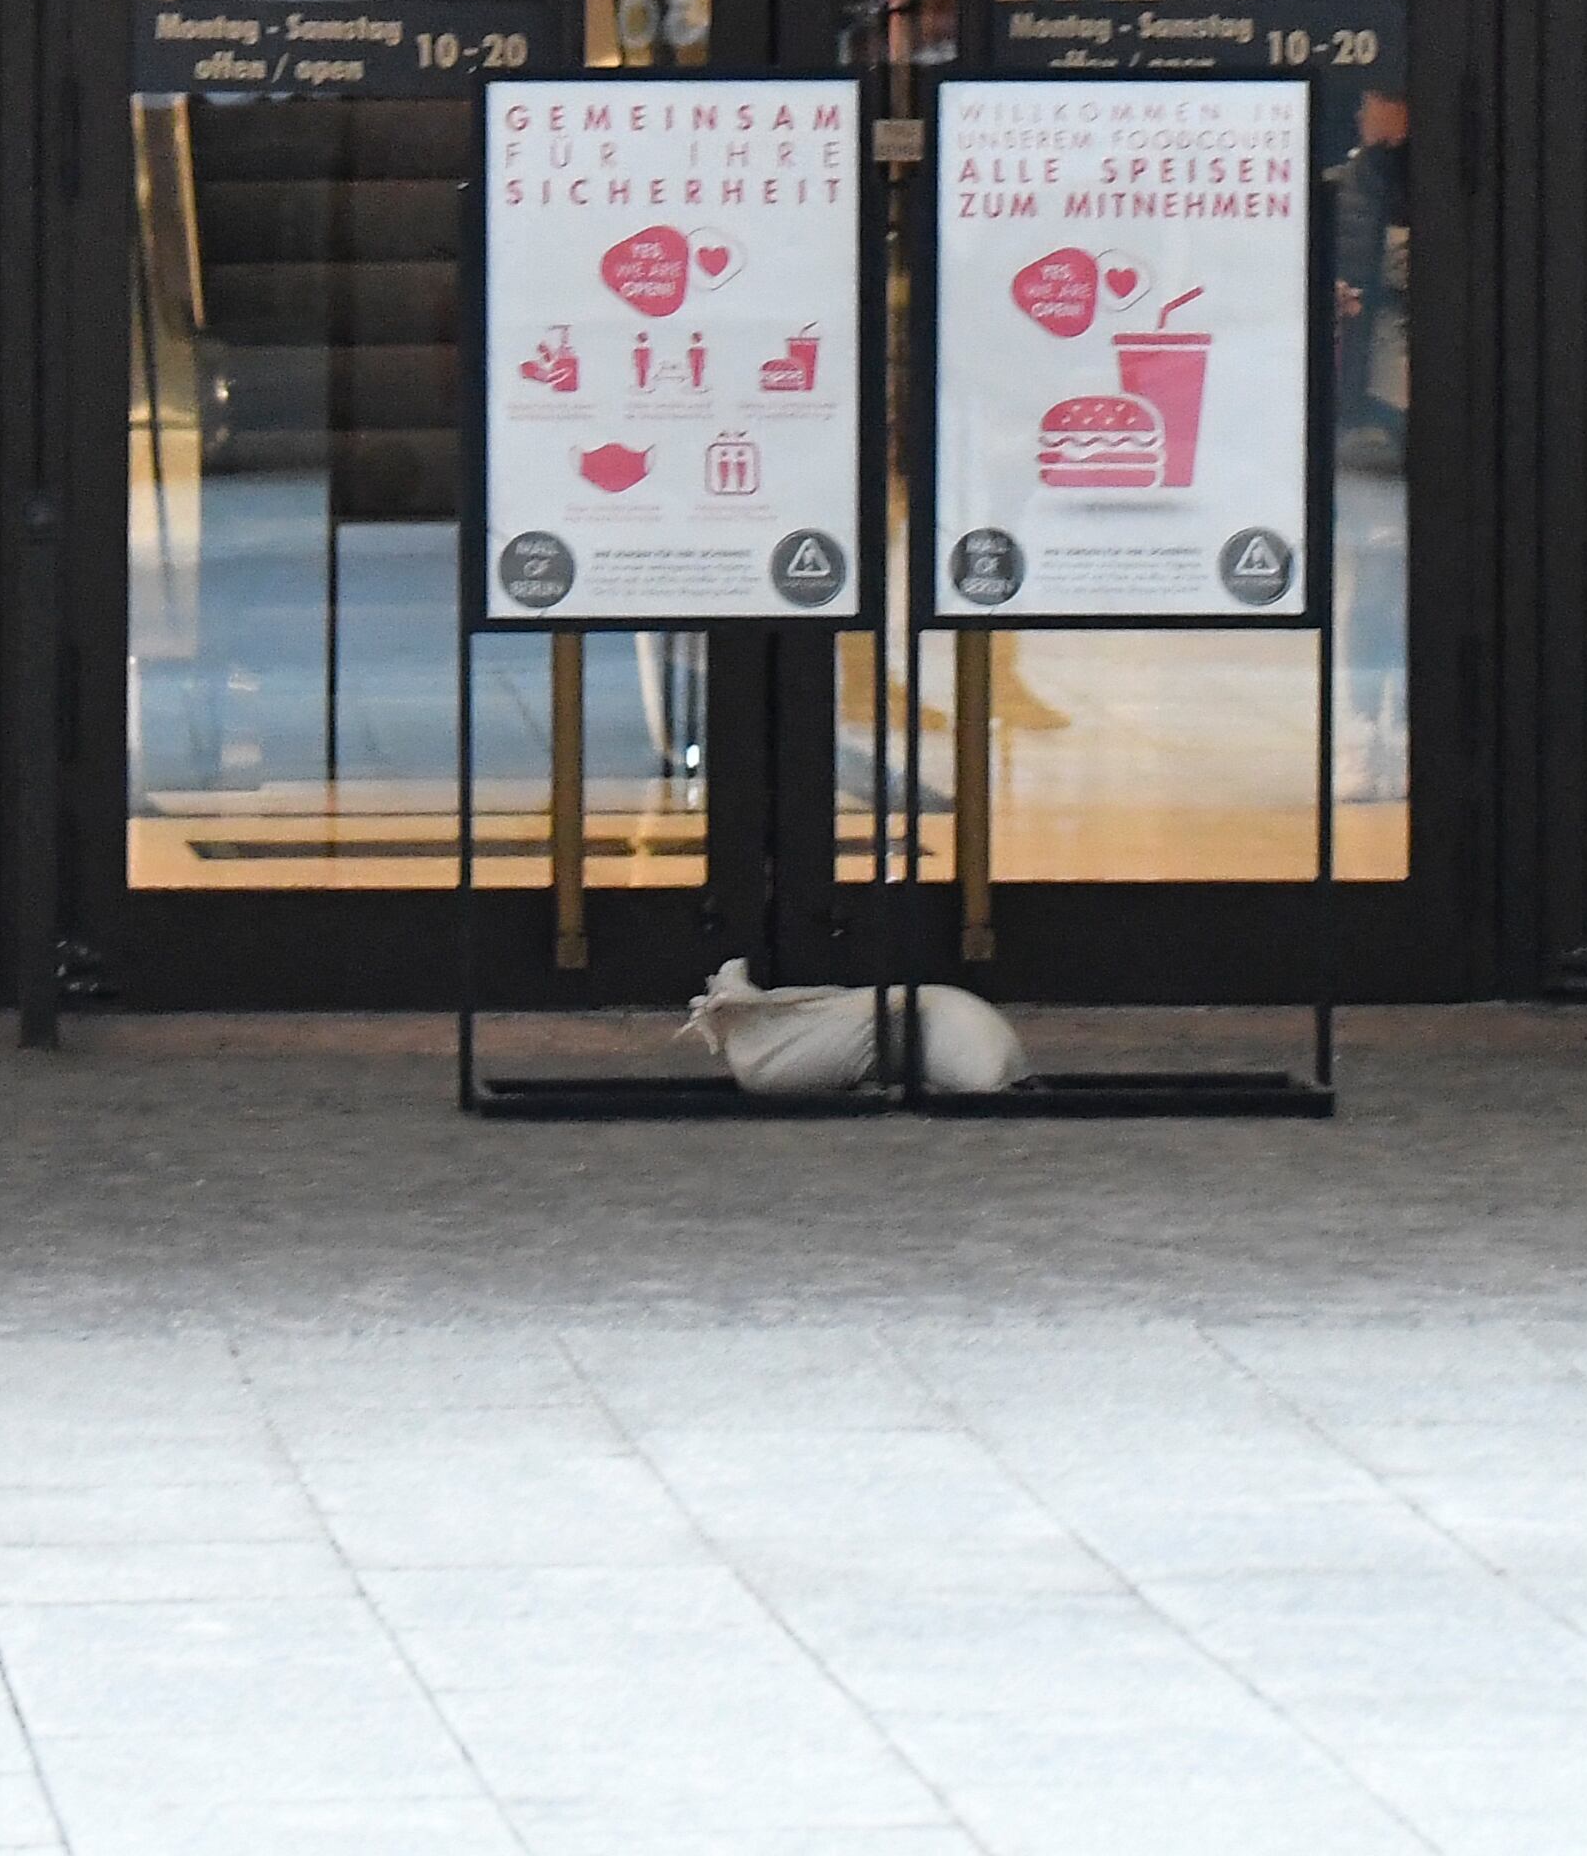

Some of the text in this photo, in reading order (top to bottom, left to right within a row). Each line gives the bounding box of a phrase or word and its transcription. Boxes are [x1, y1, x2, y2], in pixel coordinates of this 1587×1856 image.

[416, 32, 529, 70] 10-20
[1267, 29, 1379, 66] 10-20
[505, 104, 841, 133] GEMEINSAM
[957, 101, 1294, 125] WILLKOMMEN IN
[505, 134, 842, 169] FÜR IHRE
[957, 127, 1293, 152] UNSEREM FOODCOURT
[957, 155, 1293, 185] ALLE SPEISEN
[505, 177, 842, 206] SICHERHEIT
[957, 190, 1293, 220] ZUM MITNEHMEN
